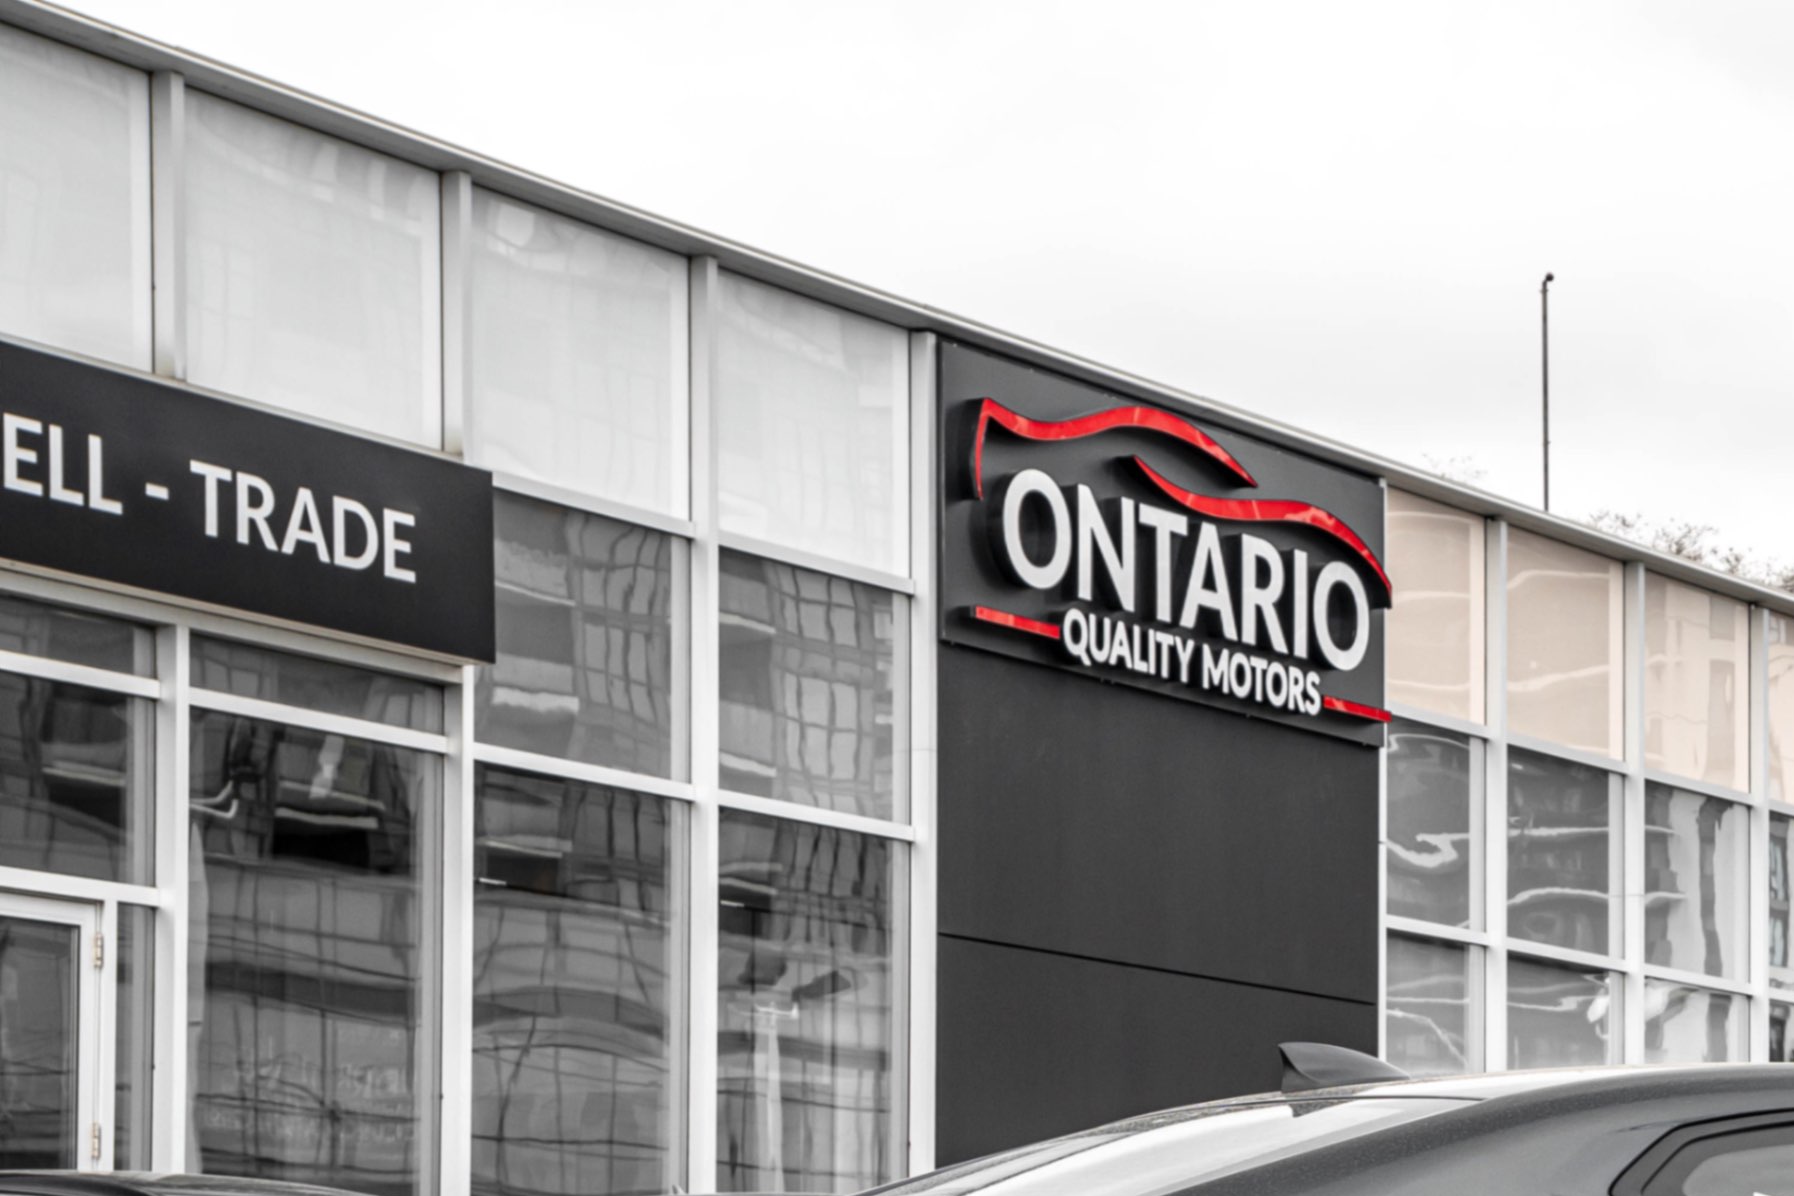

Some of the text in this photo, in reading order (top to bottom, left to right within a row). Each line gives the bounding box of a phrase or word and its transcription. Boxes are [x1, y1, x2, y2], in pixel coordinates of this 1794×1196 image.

[190, 459, 416, 584] TRADE
[1003, 468, 1370, 670] ONTARIO
[1063, 607, 1321, 716] QUALITY MOTORS
